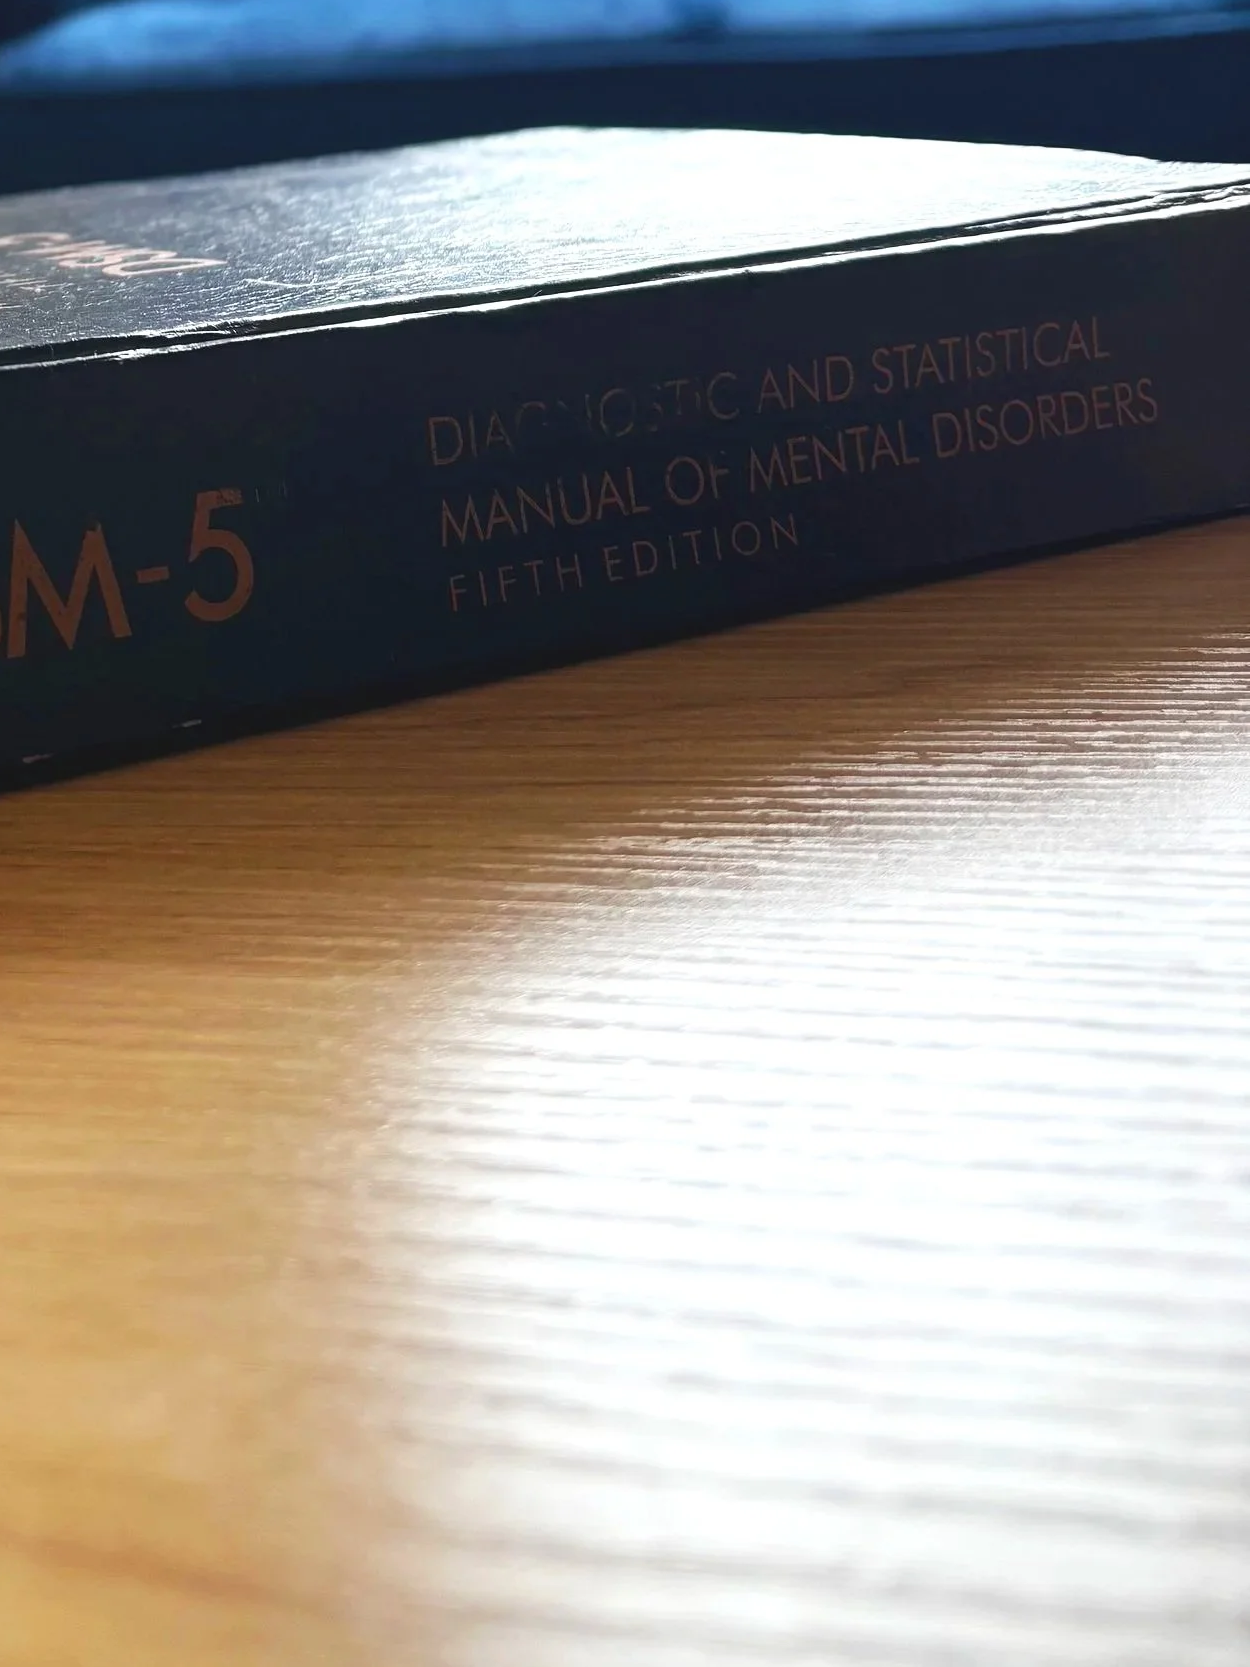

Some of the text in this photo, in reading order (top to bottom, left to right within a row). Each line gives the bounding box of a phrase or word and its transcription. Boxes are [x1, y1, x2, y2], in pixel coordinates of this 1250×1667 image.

[758, 355, 855, 412] AND
[871, 317, 1110, 394] STATISTICAL
[440, 377, 1159, 547] MANUAL OF MENTAL DISORDERS
[448, 513, 799, 612] FIFTH EDITION
